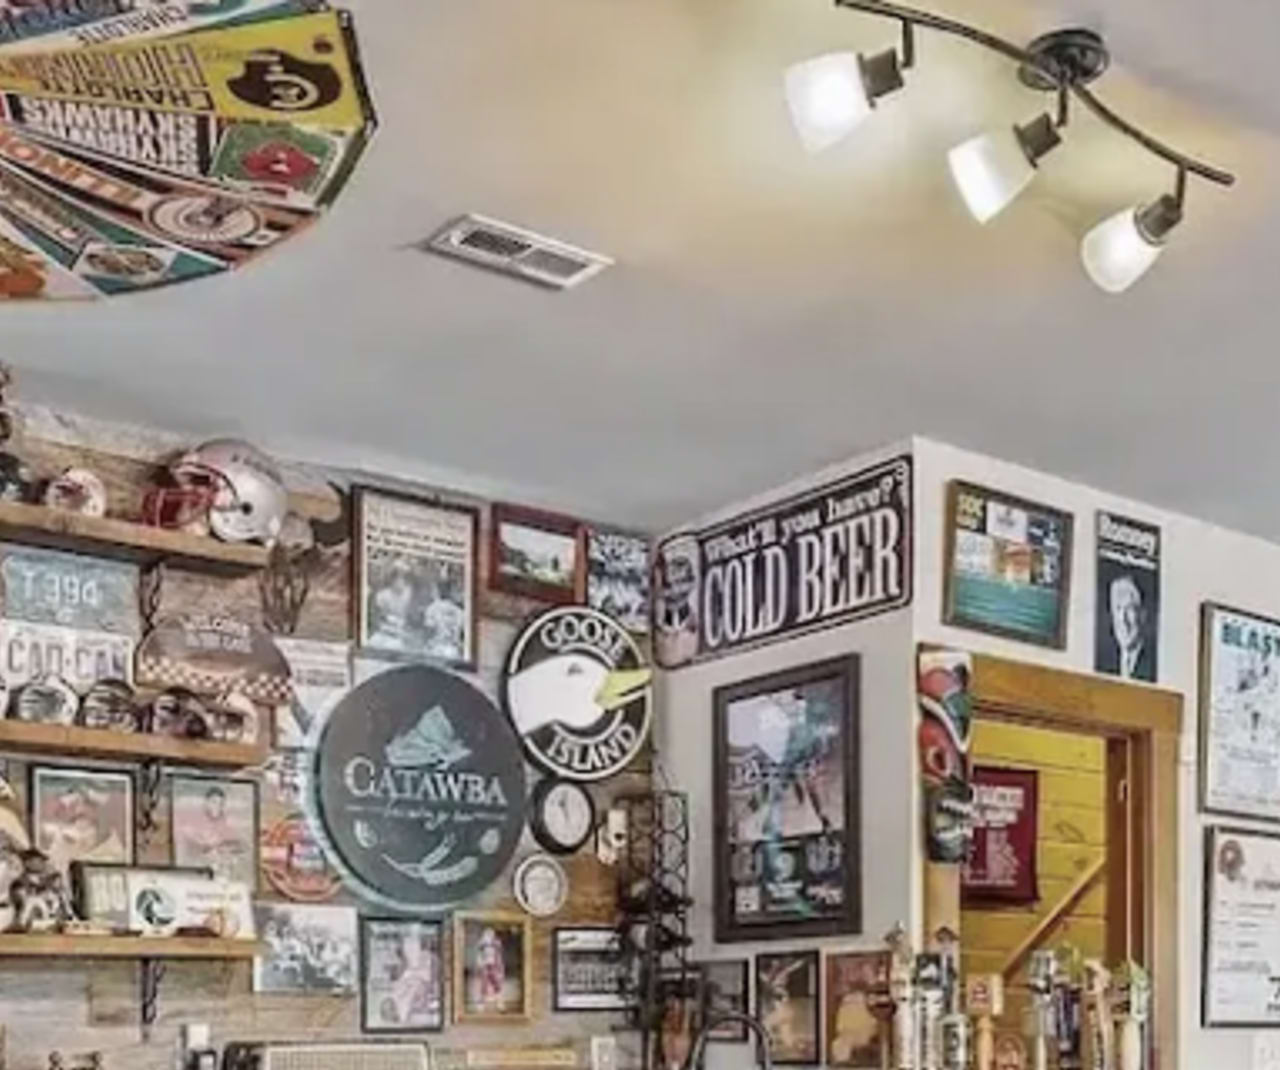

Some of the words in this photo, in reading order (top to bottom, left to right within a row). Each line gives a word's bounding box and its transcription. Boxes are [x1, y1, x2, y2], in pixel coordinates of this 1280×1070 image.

[20, 100, 199, 145] SKYHAWKS
[707, 518, 777, 562] What'll
[782, 509, 820, 546] you
[827, 474, 895, 522] have?
[1098, 513, 1158, 555] Romney
[45, 573, 104, 608] 394
[704, 544, 789, 648] COLD
[795, 506, 902, 624] BEER
[539, 615, 625, 664] GOOSE
[547, 722, 637, 772] ISLAND
[344, 756, 508, 807] CATAWBA
